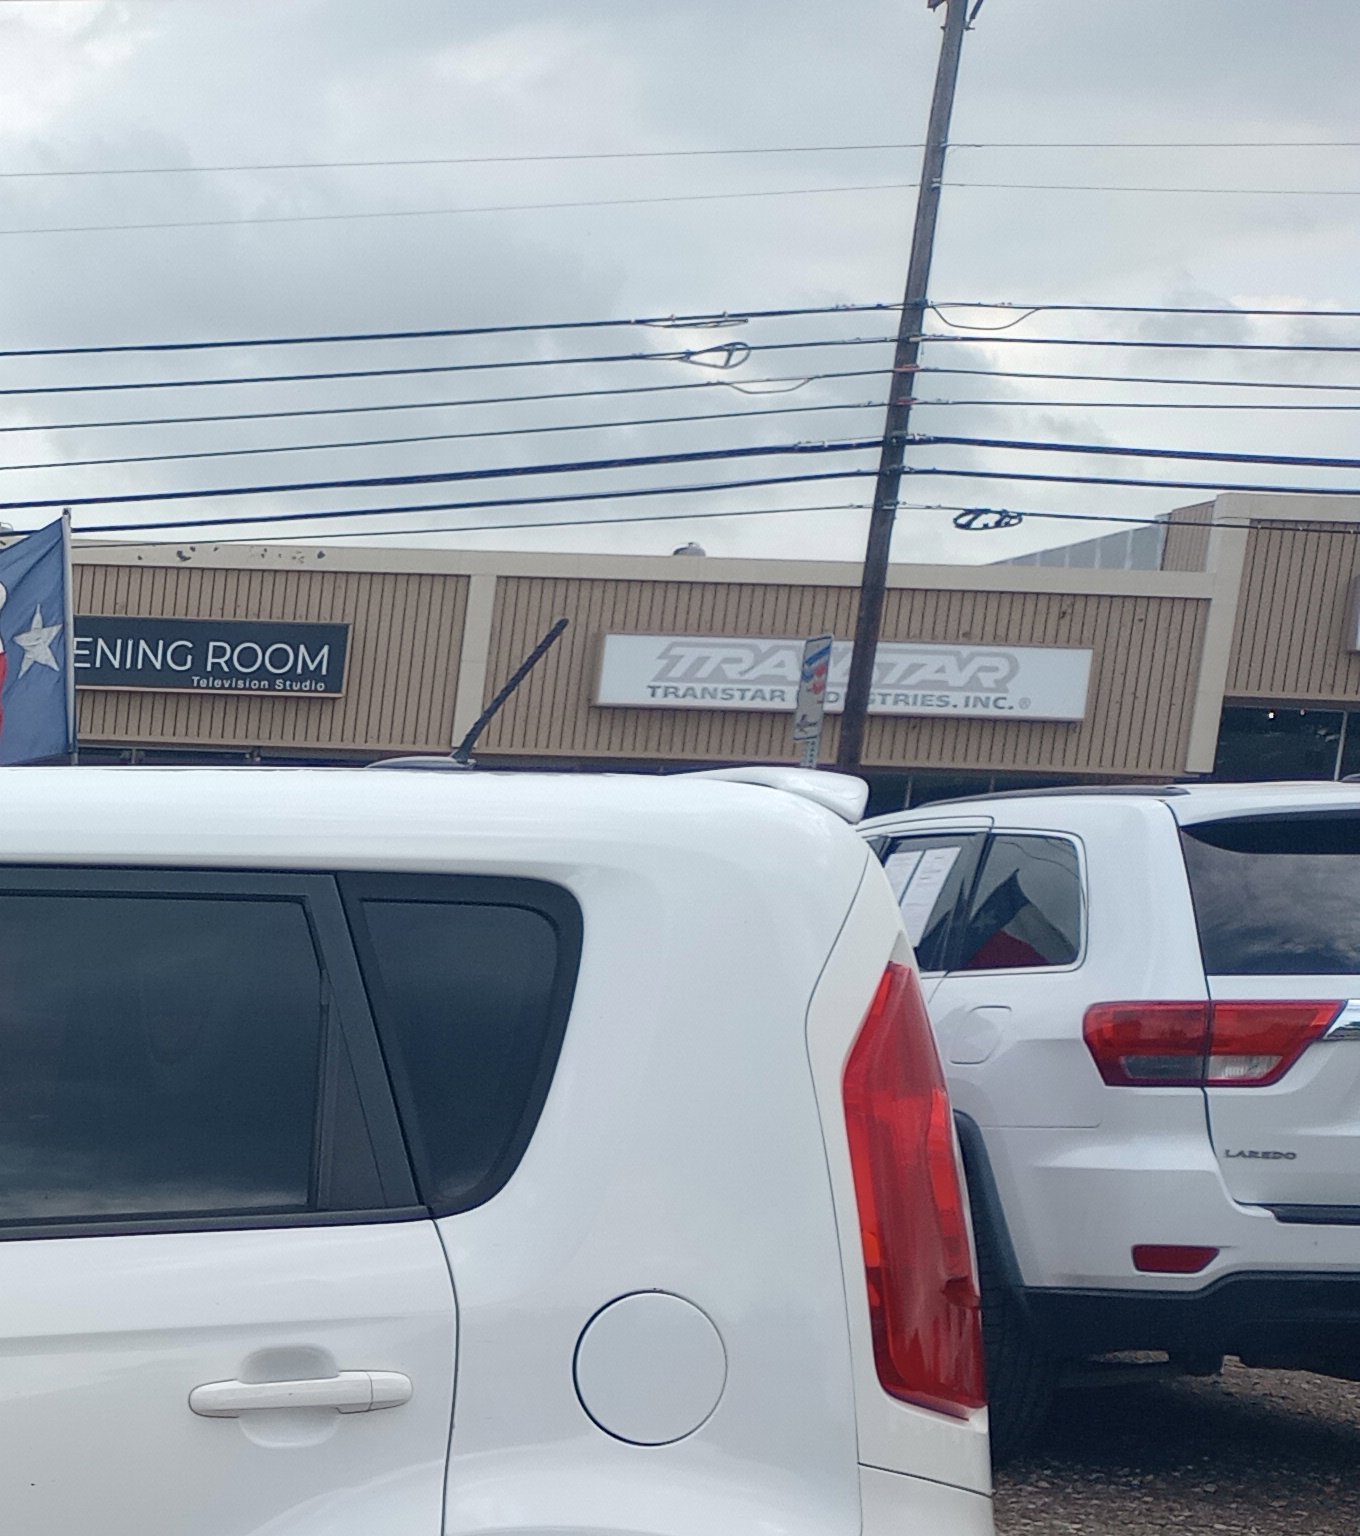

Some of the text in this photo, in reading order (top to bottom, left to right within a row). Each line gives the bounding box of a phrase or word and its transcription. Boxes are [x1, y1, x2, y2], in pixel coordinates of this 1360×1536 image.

[206, 641, 330, 675] ROOM
[651, 641, 1020, 693] TRATAR
[192, 676, 326, 691] Television Studio
[647, 685, 786, 702] TRANSTAR
[964, 695, 1014, 710] INC.
